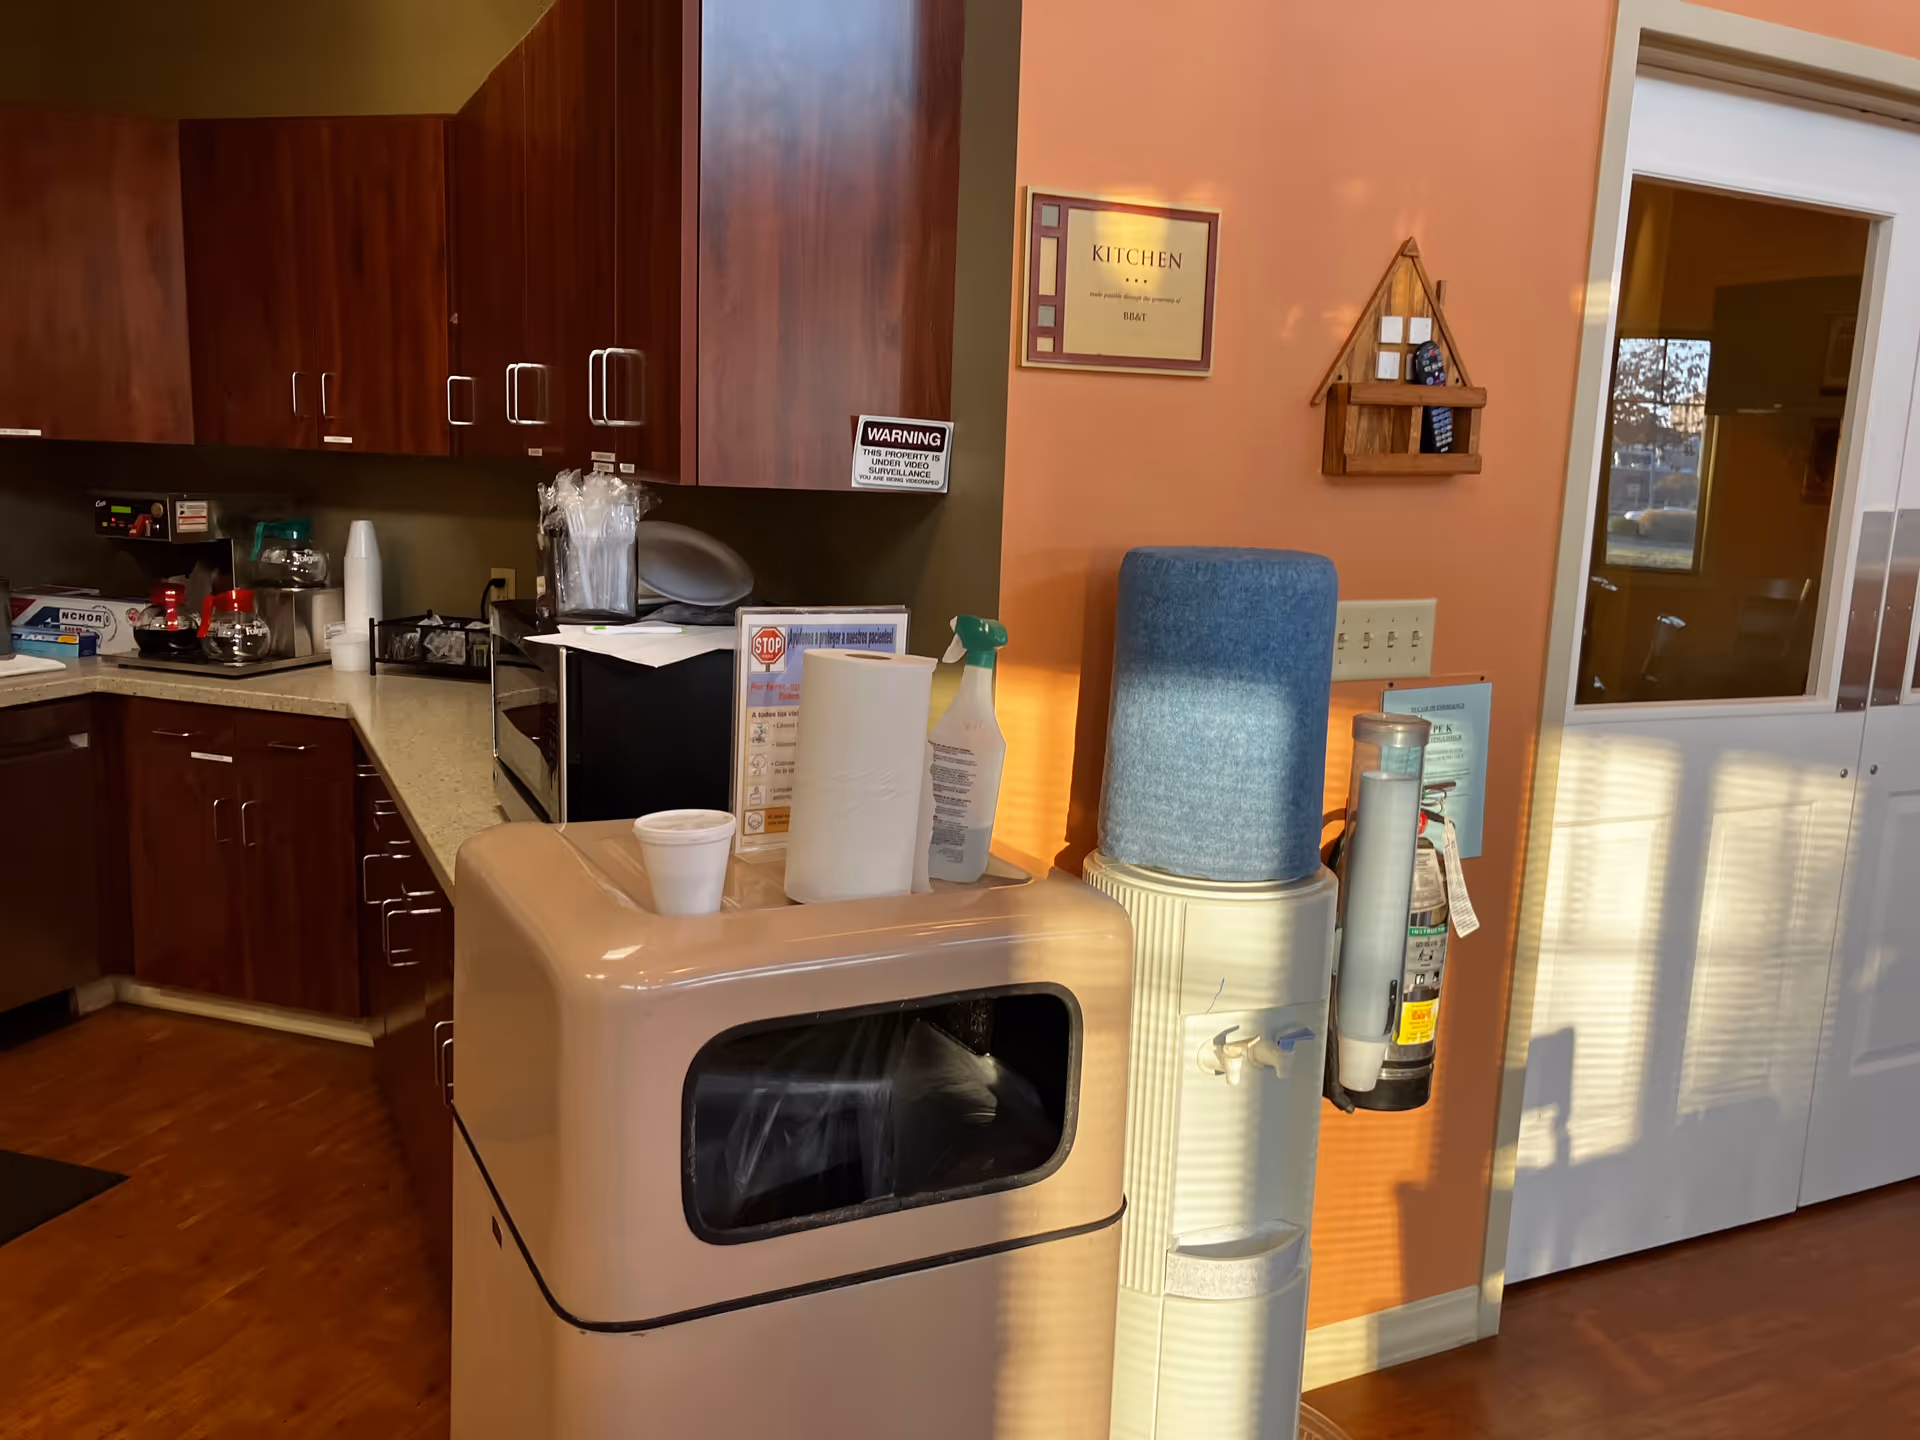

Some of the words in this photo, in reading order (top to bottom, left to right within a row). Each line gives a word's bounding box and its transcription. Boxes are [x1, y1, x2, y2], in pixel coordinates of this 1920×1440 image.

[1092, 244, 1182, 269] KITCHEN
[1123, 311, 1147, 322] BB&T
[867, 427, 942, 447] WARNING
[862, 448, 882, 457] THIS
[885, 450, 930, 461] PROPERTY
[931, 454, 940, 462] IS
[871, 458, 901, 467] UNDER
[904, 461, 929, 470] VIDEO
[868, 467, 931, 479] SURVEILLANCE
[905, 478, 939, 486] VIDEOTAPED
[846, 628, 868, 645] nuestros
[755, 637, 781, 654] STOP
[1446, 723, 1453, 733] K
